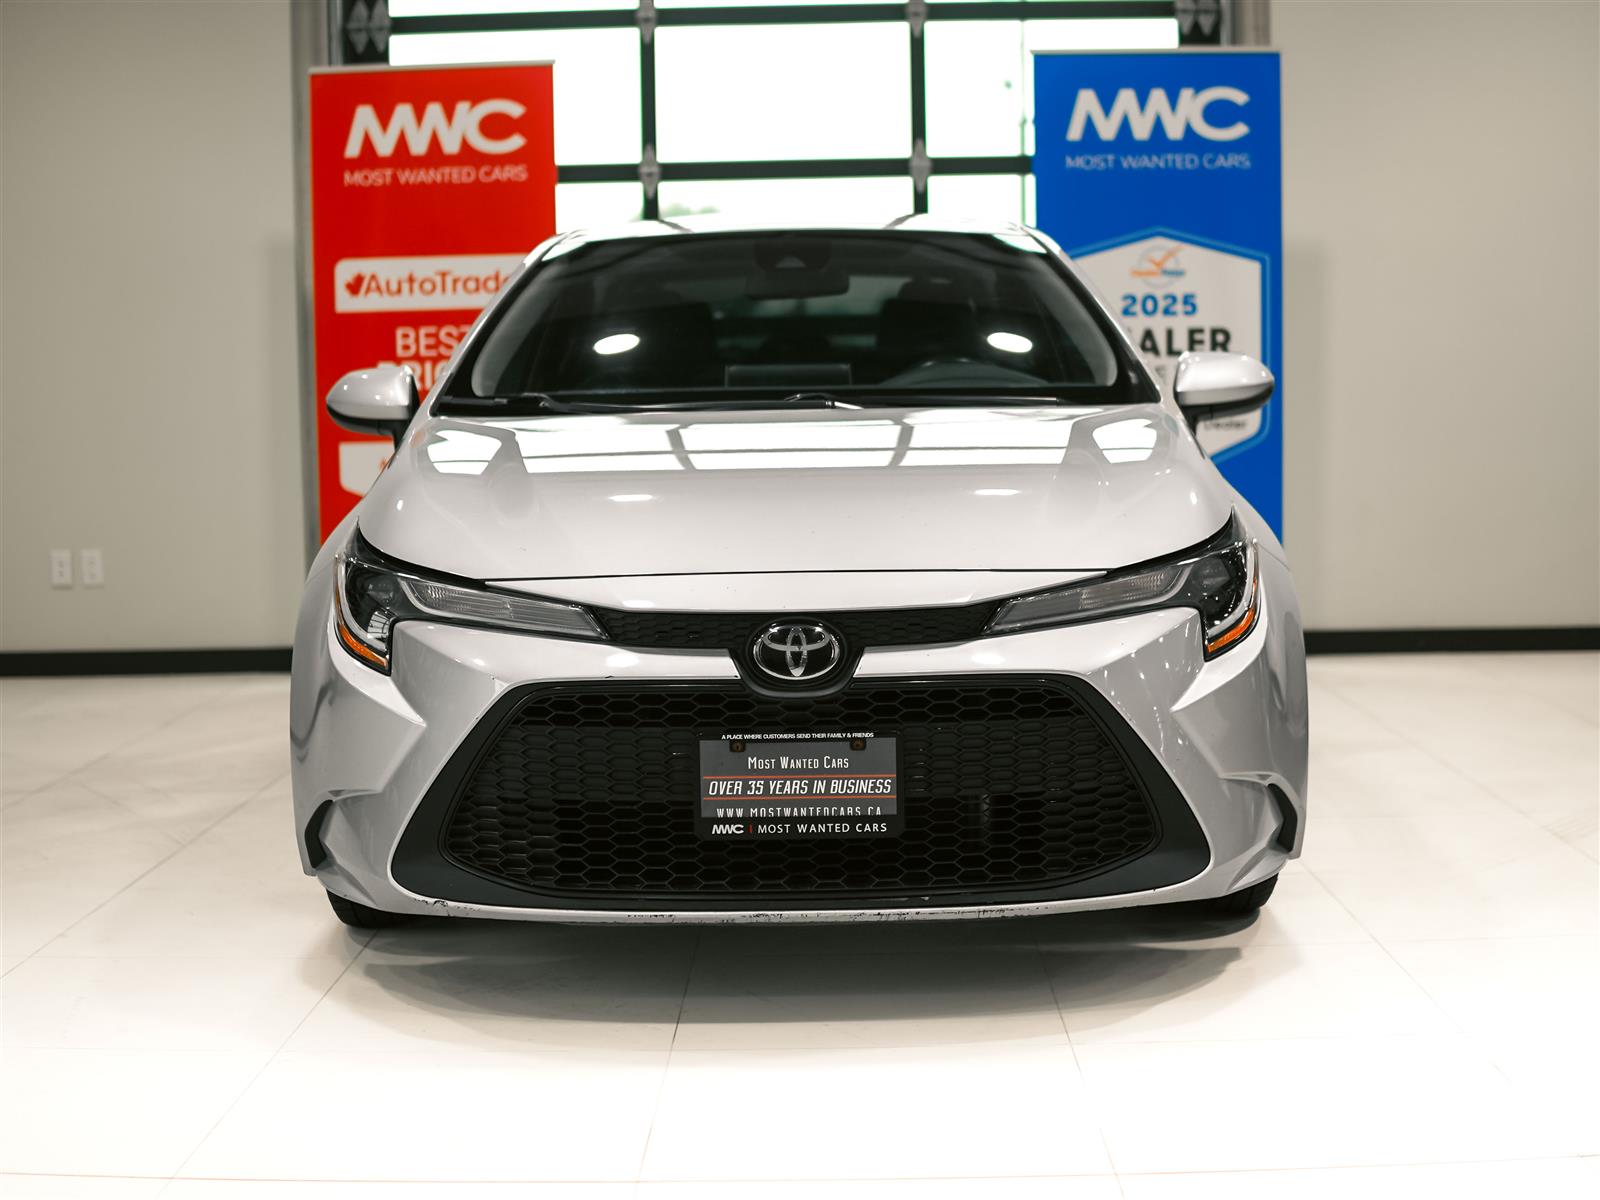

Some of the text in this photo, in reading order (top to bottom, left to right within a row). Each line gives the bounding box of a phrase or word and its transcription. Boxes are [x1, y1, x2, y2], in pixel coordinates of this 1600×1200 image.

[1066, 86, 1250, 142] MWC
[344, 98, 527, 158] MWC
[1065, 153, 1251, 169] MOST WANTED CARS
[344, 164, 528, 187] MOST WANTED CARS
[1121, 294, 1198, 316] 2025
[395, 325, 470, 358] BES
[709, 779, 892, 795] OVER 35 YEARS IN BUSINESS
[711, 823, 887, 835] MWC MOST WANTED CARS
